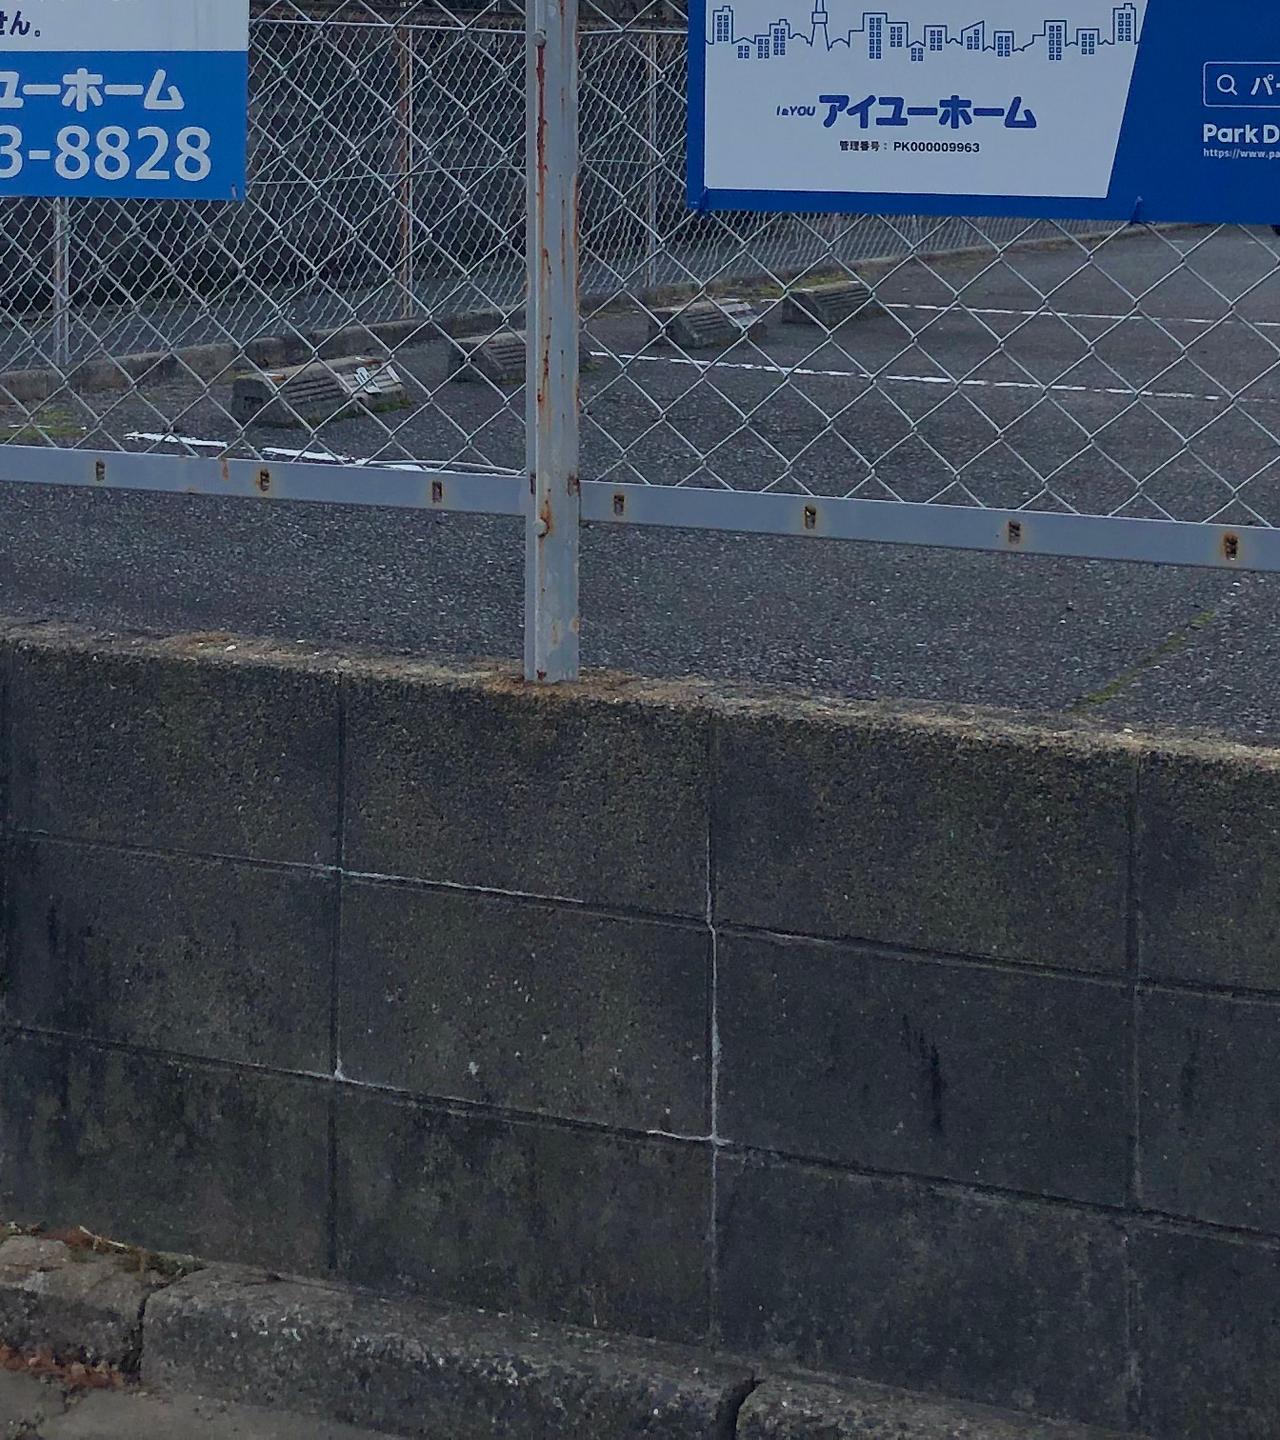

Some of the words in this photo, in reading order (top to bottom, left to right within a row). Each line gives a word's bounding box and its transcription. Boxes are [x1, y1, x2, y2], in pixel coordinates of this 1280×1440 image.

[818, 94, 1037, 129] アイユーホーム
[1203, 123, 1259, 145] Park
